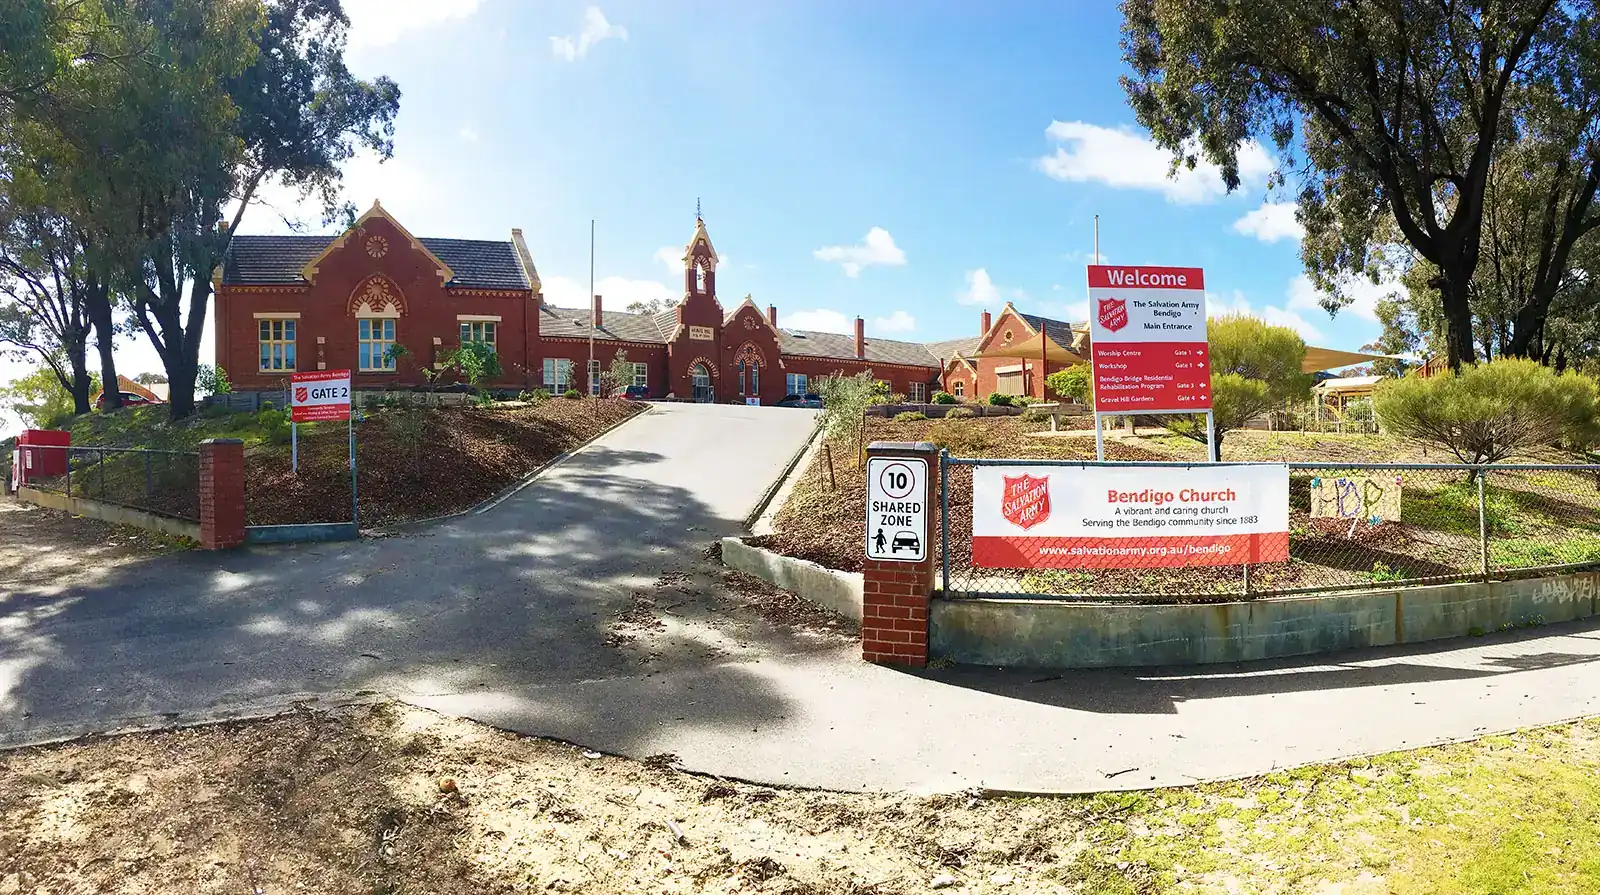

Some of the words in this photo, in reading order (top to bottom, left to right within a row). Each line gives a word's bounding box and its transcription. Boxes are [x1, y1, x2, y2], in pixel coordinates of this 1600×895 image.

[1107, 269, 1188, 286] Welcome
[1103, 301, 1115, 313] THE
[1133, 300, 1146, 308] The
[1148, 301, 1179, 309] Salvation
[1181, 301, 1200, 310] Army
[1099, 303, 1126, 324] SALVATION
[1153, 310, 1182, 319] Bendigo
[1109, 313, 1125, 329] ARMY
[1143, 322, 1161, 331] Main
[1162, 322, 1193, 331] Entrance
[312, 388, 338, 398] GATE
[341, 387, 348, 398] 2
[888, 473, 907, 489] 10
[1010, 478, 1030, 497] THE
[1003, 481, 1048, 516] SALVATION
[1107, 489, 1175, 506] Bendigo
[1178, 488, 1236, 503] Church
[872, 501, 921, 513] SHARED
[1020, 497, 1045, 523] ARMY
[1114, 507, 1121, 516] A
[1123, 506, 1152, 516] vibrant
[1154, 507, 1171, 516] and
[1172, 507, 1199, 517] caring
[1200, 506, 1229, 515] church
[881, 515, 912, 526] ZONE
[1082, 518, 1114, 529] Serving
[1116, 518, 1131, 527] the
[1132, 518, 1167, 528] Bendigo
[1168, 517, 1214, 528] community
[1216, 516, 1238, 526] since
[1239, 515, 1259, 525] 1883
[1039, 543, 1231, 557] www.salvationarmy.org.au/bendigo
